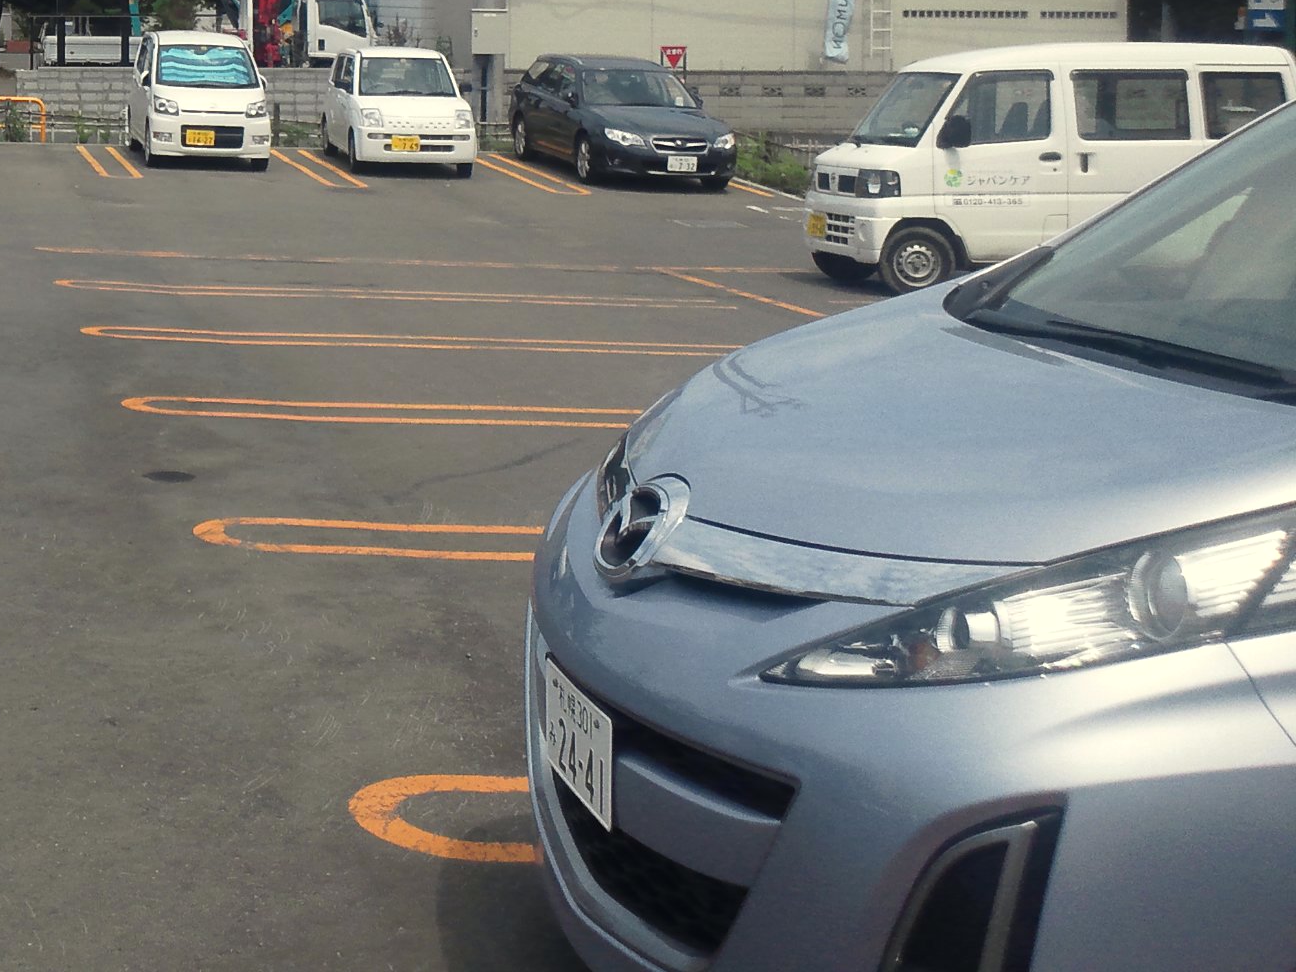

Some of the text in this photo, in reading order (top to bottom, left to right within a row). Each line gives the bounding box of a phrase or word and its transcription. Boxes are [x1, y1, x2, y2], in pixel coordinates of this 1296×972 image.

[968, 175, 1031, 186] ジャパンケア
[558, 717, 604, 816] 24-41
